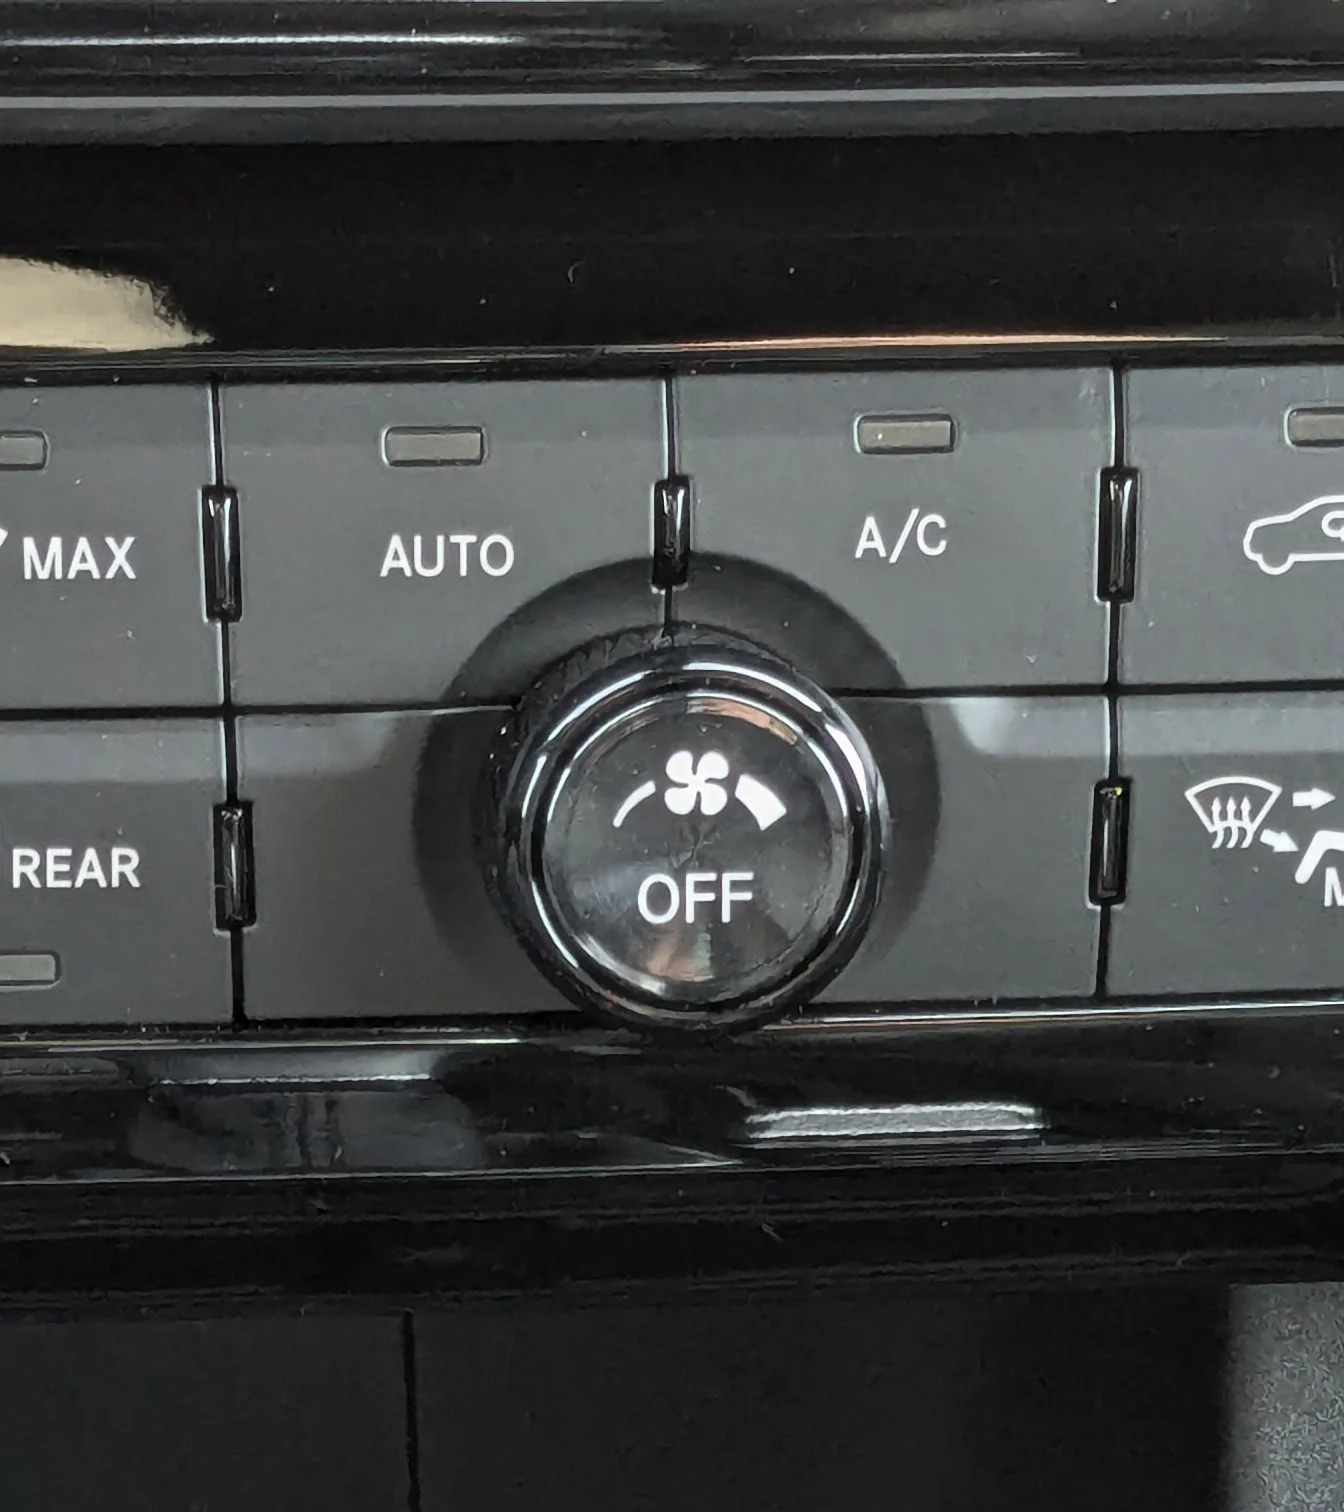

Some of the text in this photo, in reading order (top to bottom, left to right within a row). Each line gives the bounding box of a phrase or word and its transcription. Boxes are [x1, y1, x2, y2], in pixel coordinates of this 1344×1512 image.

[23, 536, 136, 580] MAX
[380, 533, 515, 577] AUTO
[855, 509, 947, 564] A/C
[12, 847, 140, 889] REAR
[637, 871, 754, 925] OFF
